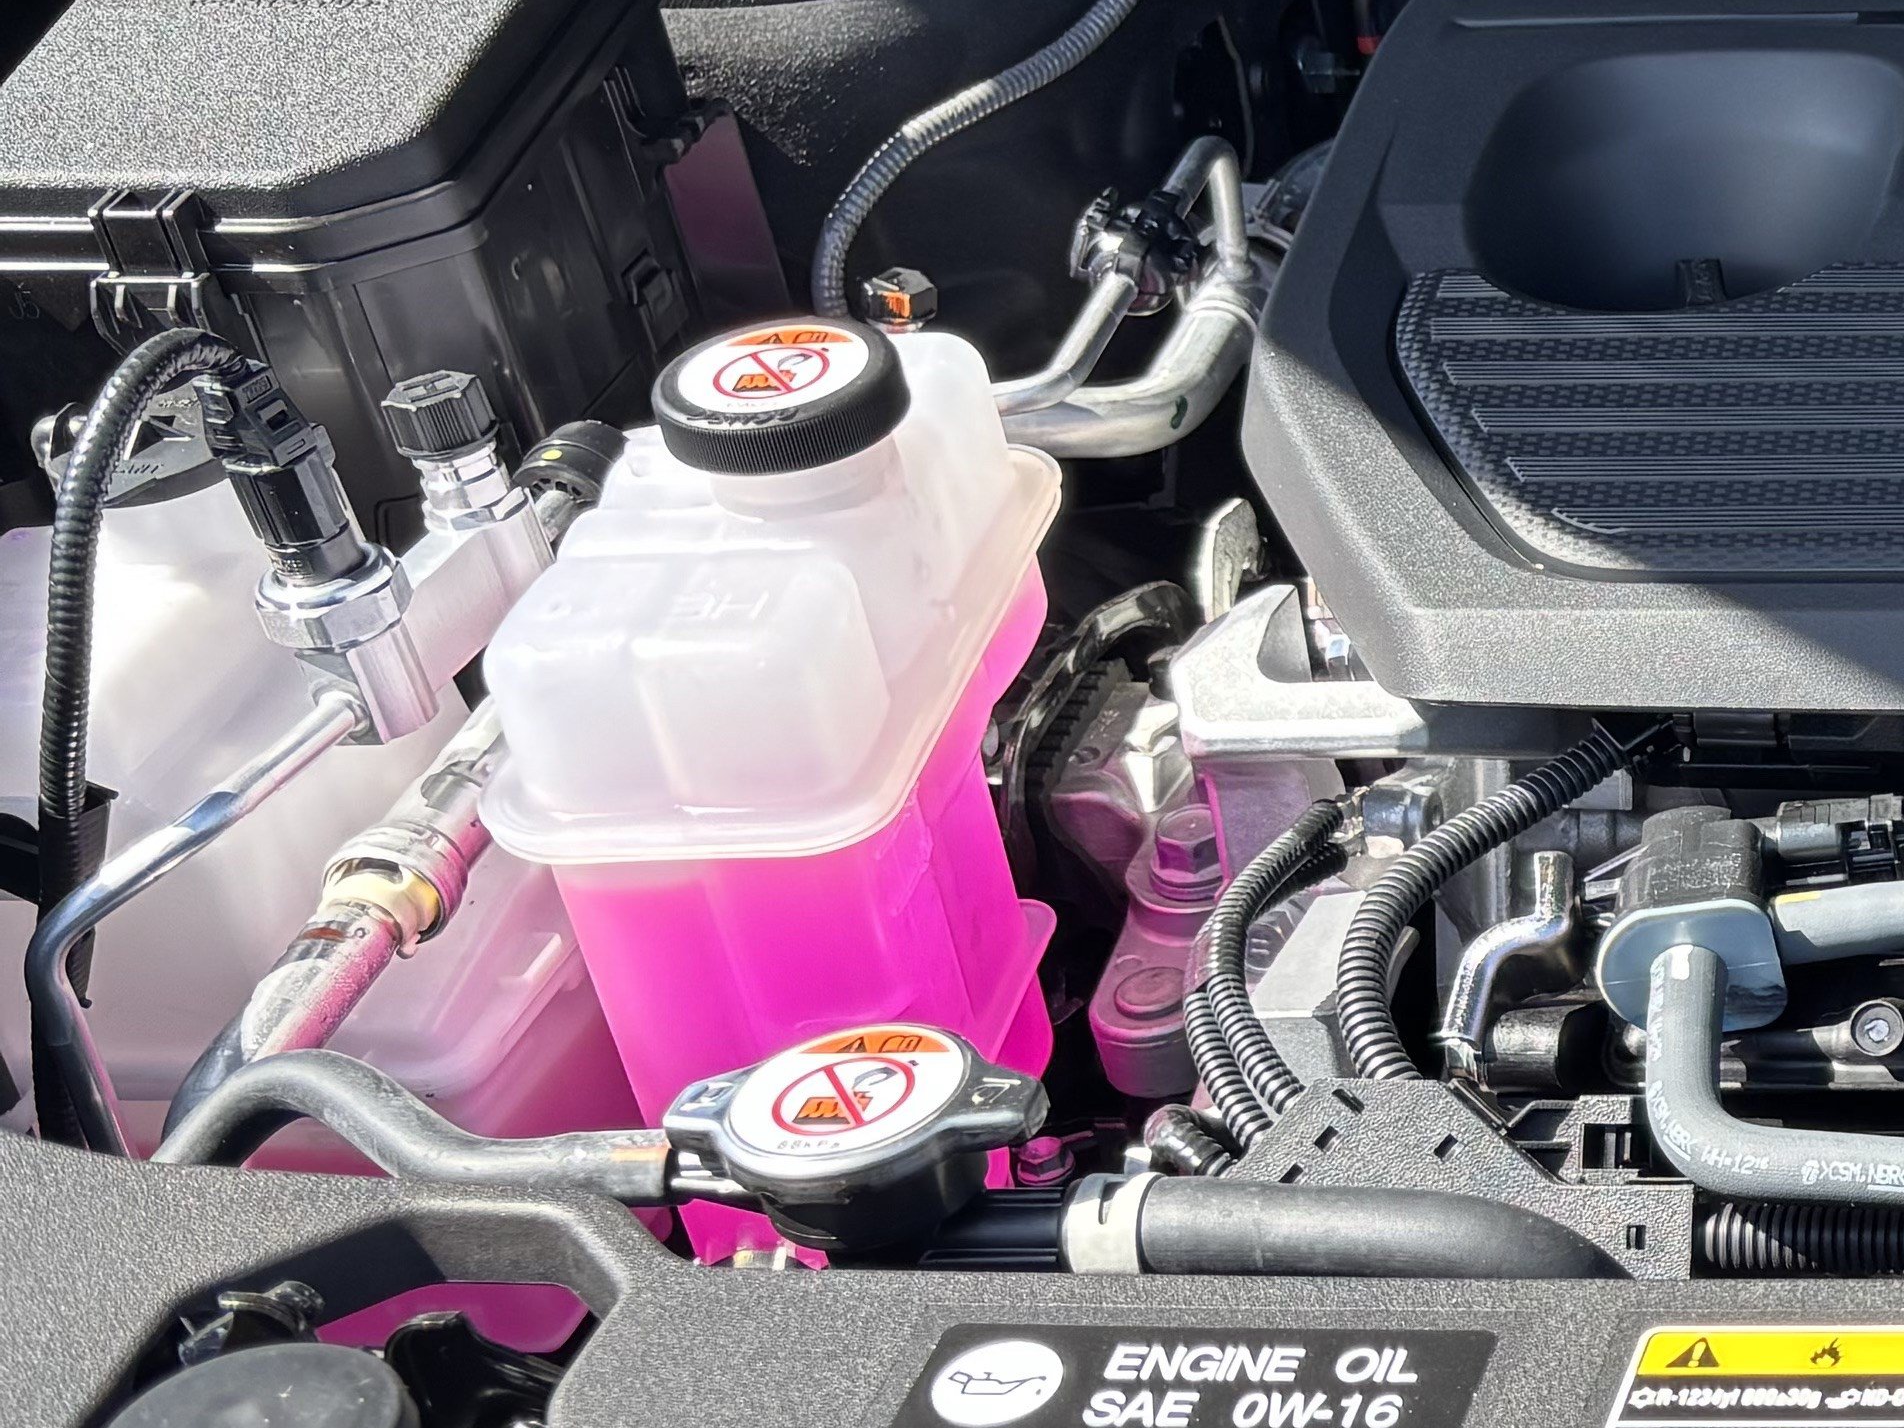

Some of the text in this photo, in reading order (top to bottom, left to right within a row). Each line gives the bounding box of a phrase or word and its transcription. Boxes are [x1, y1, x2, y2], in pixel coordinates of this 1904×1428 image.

[1103, 1343, 1419, 1384] ENGINE OIL
[1082, 1390, 1200, 1428] SAE
